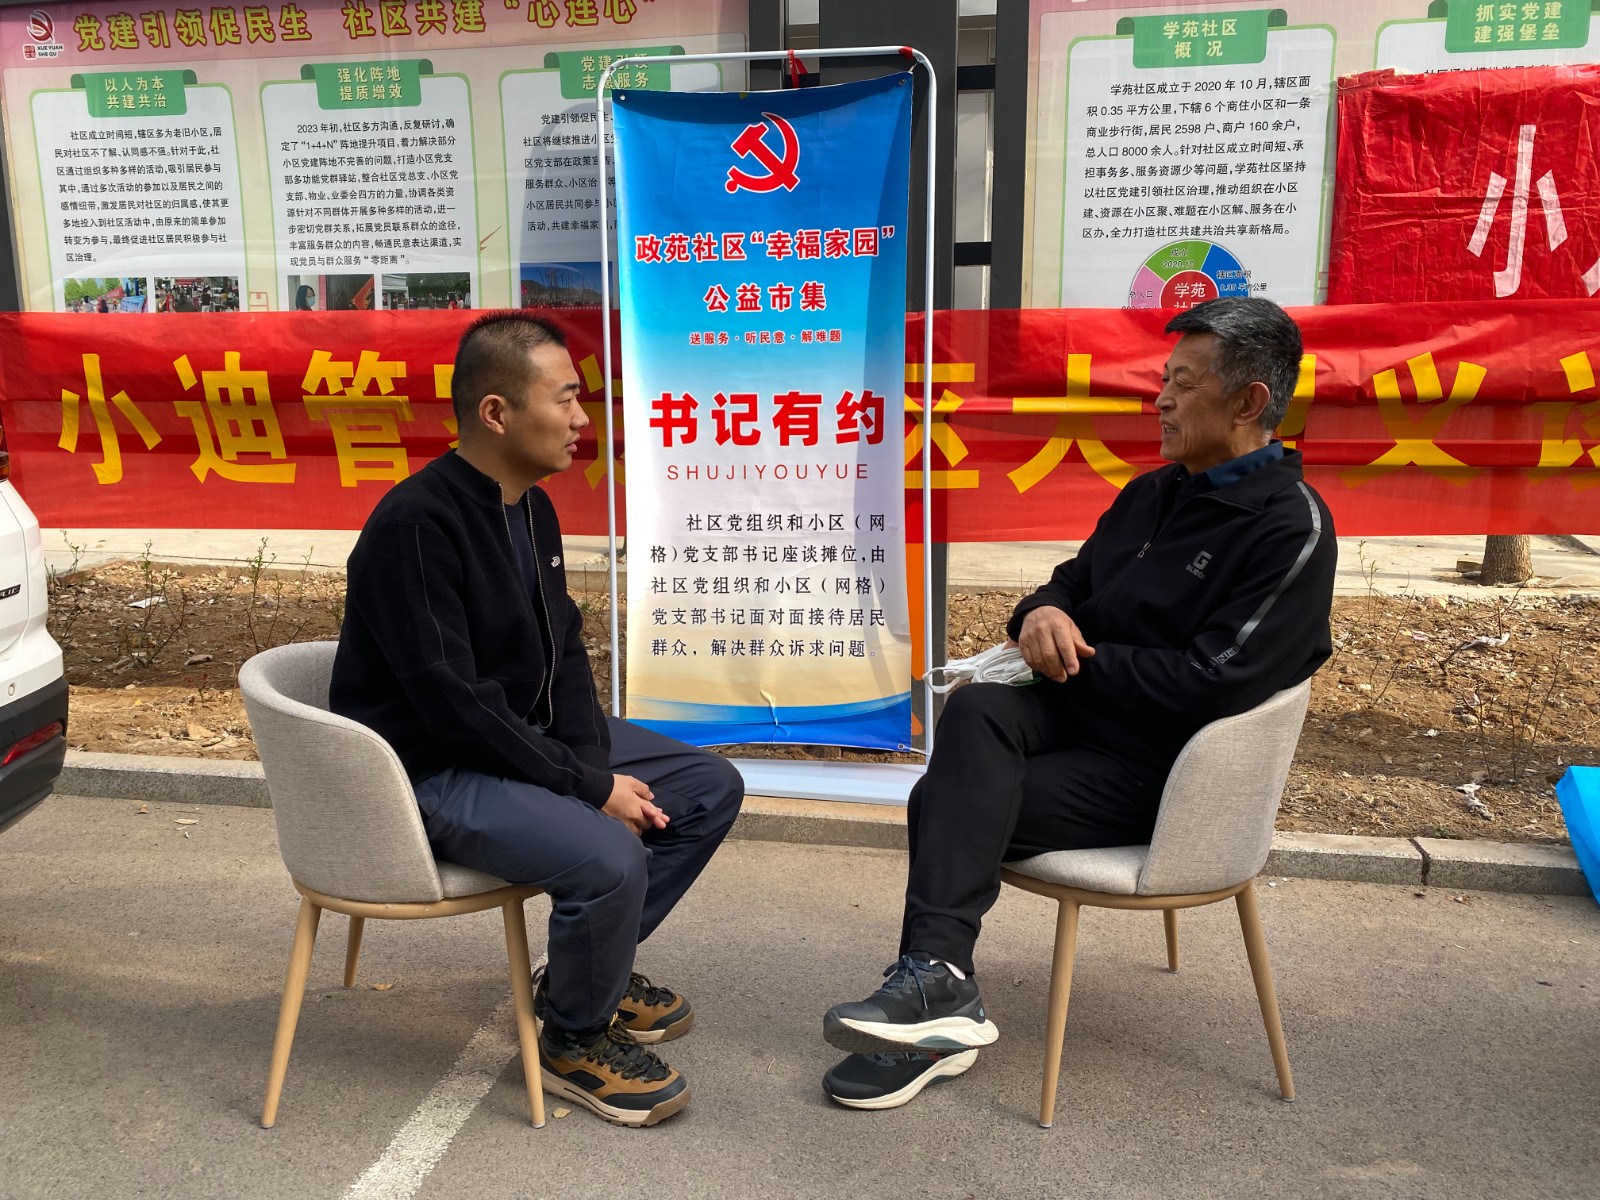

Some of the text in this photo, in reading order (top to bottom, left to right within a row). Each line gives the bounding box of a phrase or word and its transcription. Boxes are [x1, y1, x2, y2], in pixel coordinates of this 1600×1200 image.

[1475, 2, 1562, 22] 抓实党建
[73, 3, 313, 52] 党建引领促民生
[1162, 18, 1238, 39] 学苑社区
[1474, 23, 1559, 43] 建强堡垒
[104, 75, 165, 92] 以人为本
[337, 66, 401, 83] 强化阵地
[340, 83, 403, 102] 提质增效
[1110, 82, 1192, 96] 学苑社区成立于
[1194, 81, 1222, 92] 2020
[1224, 79, 1236, 91] 年
[1240, 79, 1252, 90] 10
[106, 94, 167, 109] 共建共治
[1086, 106, 1098, 117] 积
[1101, 106, 1123, 116] 0.35
[1205, 102, 1212, 113] 6
[1214, 97, 1311, 113] 个商住小区和一条
[297, 124, 318, 134] 2023
[1086, 125, 1172, 138] 商业步行街，居民
[1175, 124, 1201, 135] 2598
[1249, 121, 1269, 132] 160
[1085, 146, 1119, 157] 总人口
[1122, 146, 1148, 156] 8000
[525, 176, 615, 189] 服务群众、小区治等
[1084, 181, 1298, 198] 以社区党建引领社区治理，推动组织在小区
[635, 226, 895, 263] 政苑社区“幸福家园”
[703, 281, 827, 313] 公益市集
[1174, 282, 1207, 298] 学苑
[649, 390, 886, 448] 书记有约
[667, 464, 869, 480] SHUJIYOUYUE
[686, 513, 885, 531] 社区党组织和小区（网
[650, 545, 885, 563] 格）党支部书记座谈摊位，由
[651, 576, 885, 594] 社区党组织和小区（网格）
[651, 608, 885, 626] 党支部书记面对面接待居民
[651, 638, 876, 657] 群众，解决群众诉求问题。
